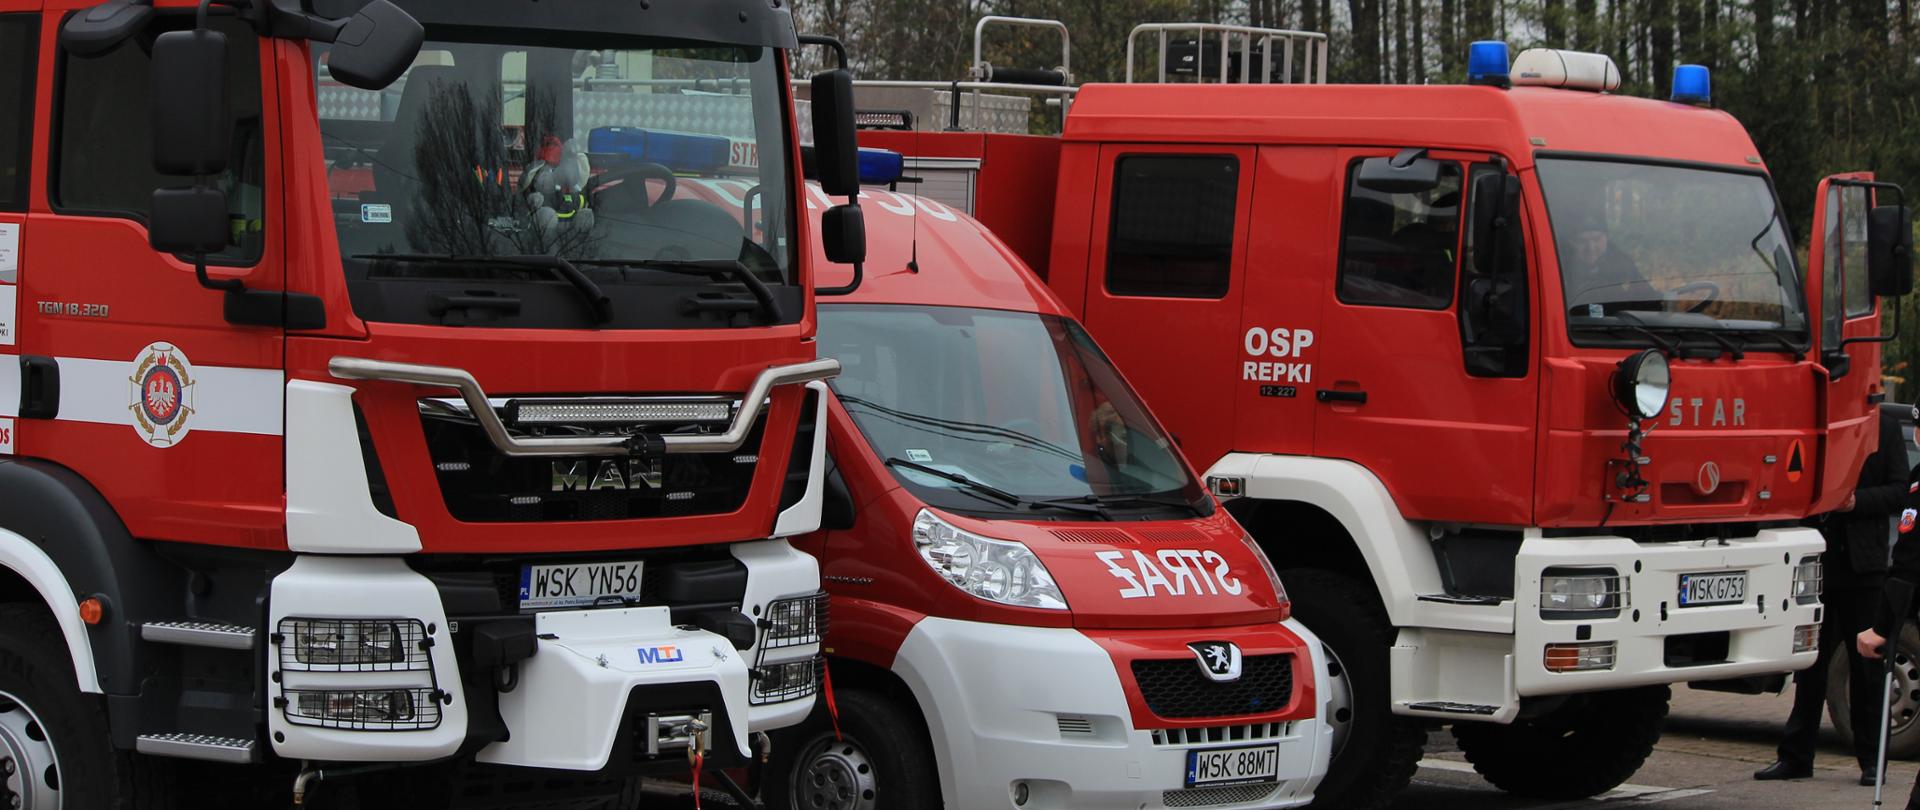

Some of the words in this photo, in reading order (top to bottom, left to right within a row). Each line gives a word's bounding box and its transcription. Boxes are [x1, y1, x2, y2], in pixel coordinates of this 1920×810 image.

[37, 301, 63, 314] TGM
[65, 303, 109, 317] 18.320
[1244, 326, 1314, 357] OSP
[1243, 361, 1312, 384] REPKI
[1261, 386, 1296, 397] 12-227
[1669, 398, 1745, 427] STAR
[551, 459, 662, 491] MAN
[535, 567, 579, 598] WSK
[588, 564, 639, 596] YN56
[1689, 578, 1715, 601] WSK
[1716, 576, 1745, 599] G753
[1199, 752, 1233, 779] WSK
[1237, 749, 1275, 776] 88MT
